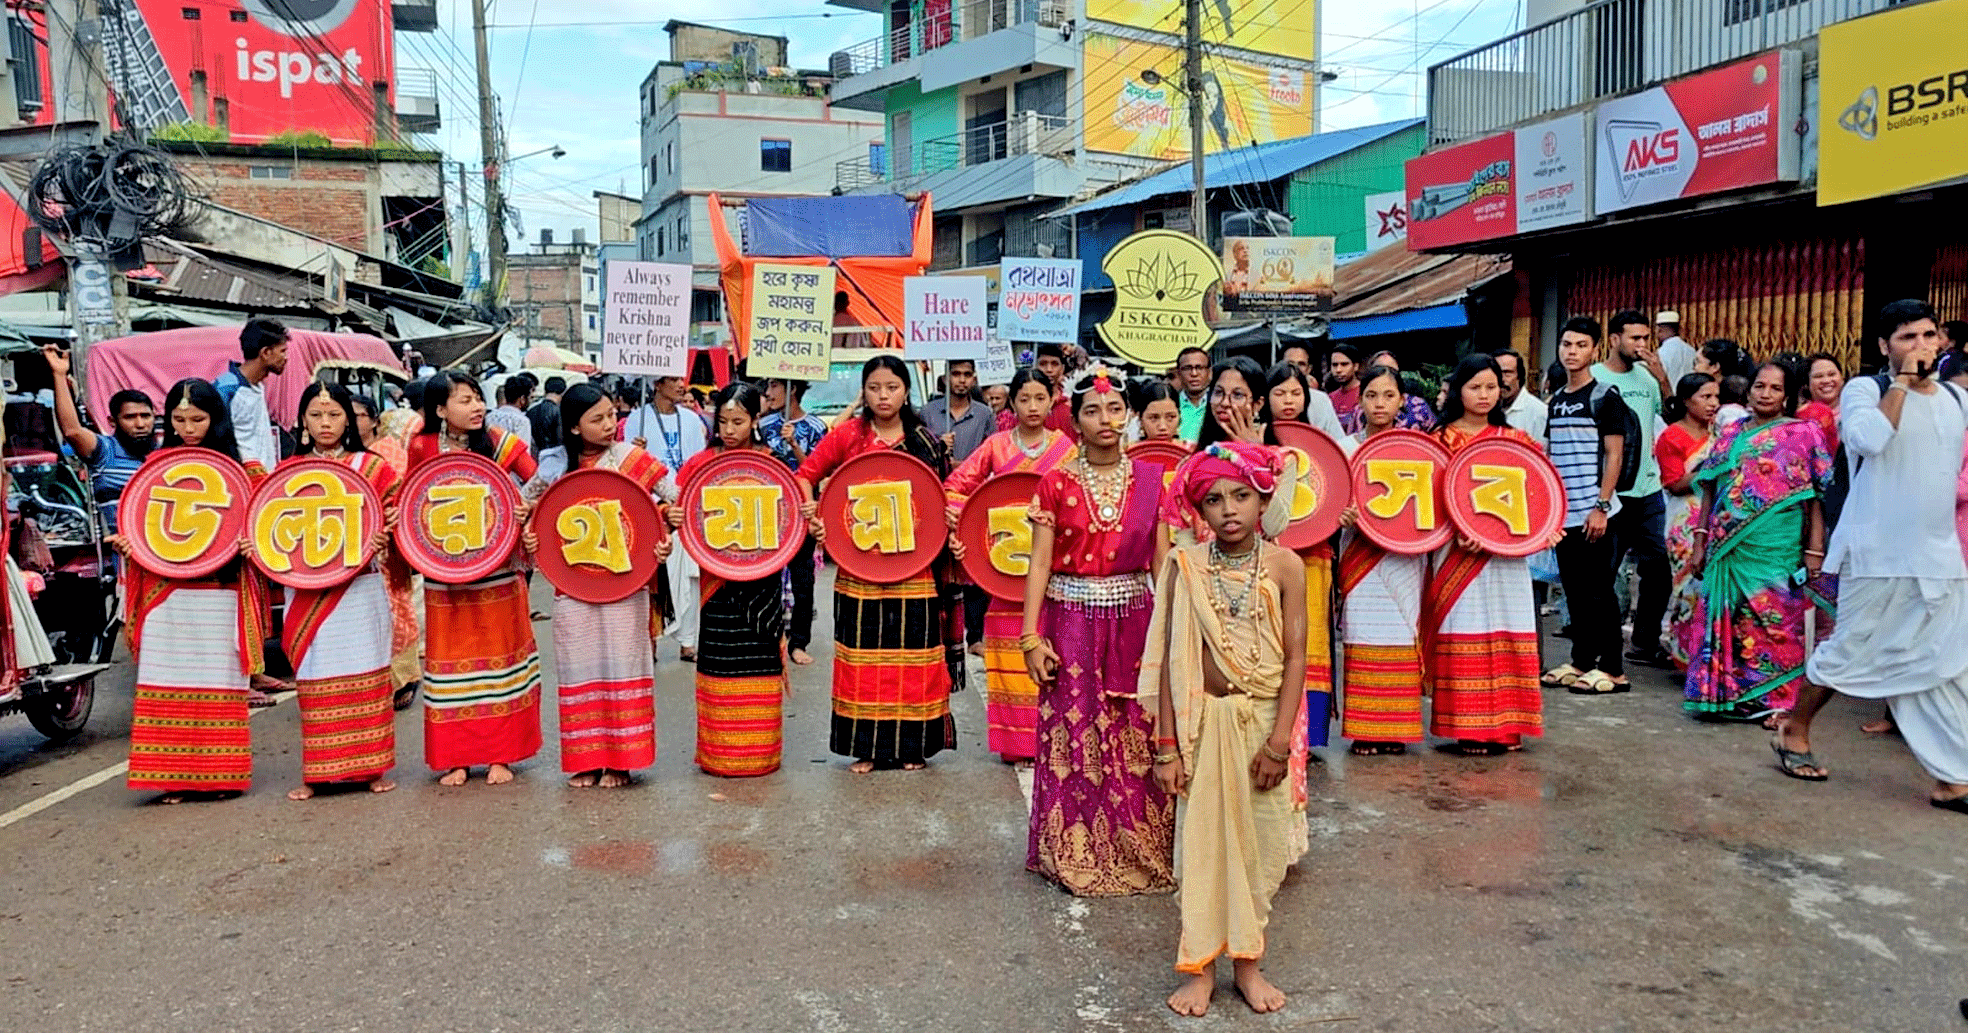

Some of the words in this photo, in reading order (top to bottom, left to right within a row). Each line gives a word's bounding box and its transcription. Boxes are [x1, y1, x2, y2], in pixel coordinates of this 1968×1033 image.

[235, 37, 363, 99] ispat
[1887, 115, 1929, 131] building
[1932, 112, 1938, 121] a
[1623, 128, 1679, 173] AKS
[1263, 248, 1297, 256] ISKCON
[624, 267, 671, 289] Always
[1008, 266, 1075, 288] রথযাত্রা
[1262, 257, 1294, 281] 60
[762, 271, 787, 286] হরে
[790, 273, 819, 292] কৃষ্ণ
[613, 289, 680, 307] remember
[768, 295, 816, 314] মহামন্ত্র
[924, 292, 969, 314] Hare
[1005, 291, 1074, 320] মহোৎসব
[619, 307, 671, 326] Krishna
[757, 316, 781, 331] জপ
[784, 318, 828, 337] করুন,
[1119, 311, 1198, 328] ISKCON
[607, 331, 642, 345] never
[646, 329, 685, 352] forget
[911, 320, 983, 342] Krishna
[1117, 331, 1198, 344] KHAGRACHARI
[752, 334, 777, 357] সুখী
[782, 340, 812, 356] হোন
[618, 348, 670, 367] Krishna
[145, 462, 230, 563] উ
[254, 470, 363, 571] ল্টো
[428, 484, 490, 555] র
[556, 500, 632, 573] থ
[702, 485, 782, 550] যা
[848, 481, 916, 554] ত্রা
[1366, 459, 1435, 530] স
[1472, 464, 1530, 535] ব
